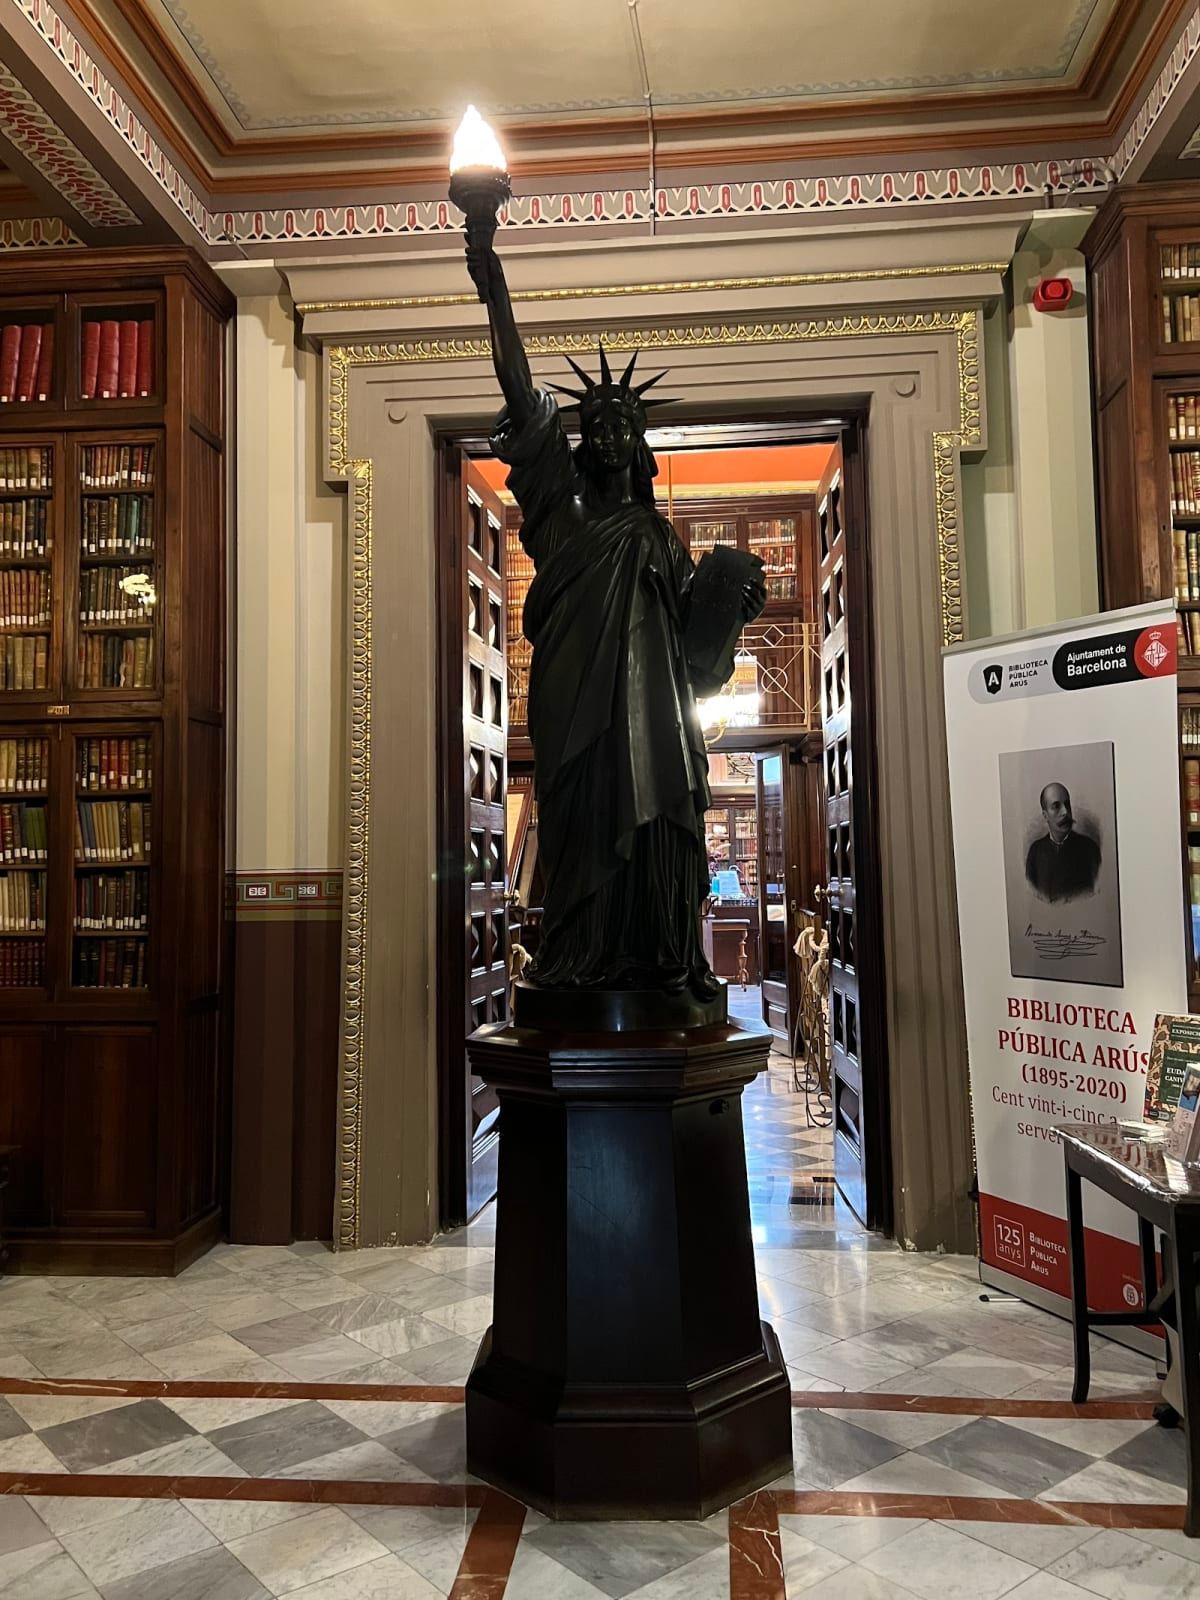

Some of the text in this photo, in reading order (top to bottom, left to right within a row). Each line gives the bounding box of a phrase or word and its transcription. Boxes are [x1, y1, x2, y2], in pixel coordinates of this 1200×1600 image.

[1066, 643, 1127, 663] Ajuntament de
[1008, 659, 1048, 672] BIBLIOTECA
[1067, 656, 1127, 677] Barcelona
[1007, 997, 1137, 1035] BIBLIOTECA
[998, 1027, 1149, 1075] PÚBLICA ARÚS
[1022, 1063, 1127, 1103] (1895-2020)
[992, 1085, 1024, 1107] Cent
[1028, 1096, 1105, 1126] vint-i-cinc
[997, 1224, 1021, 1246] 125
[999, 1243, 1022, 1259] anys
